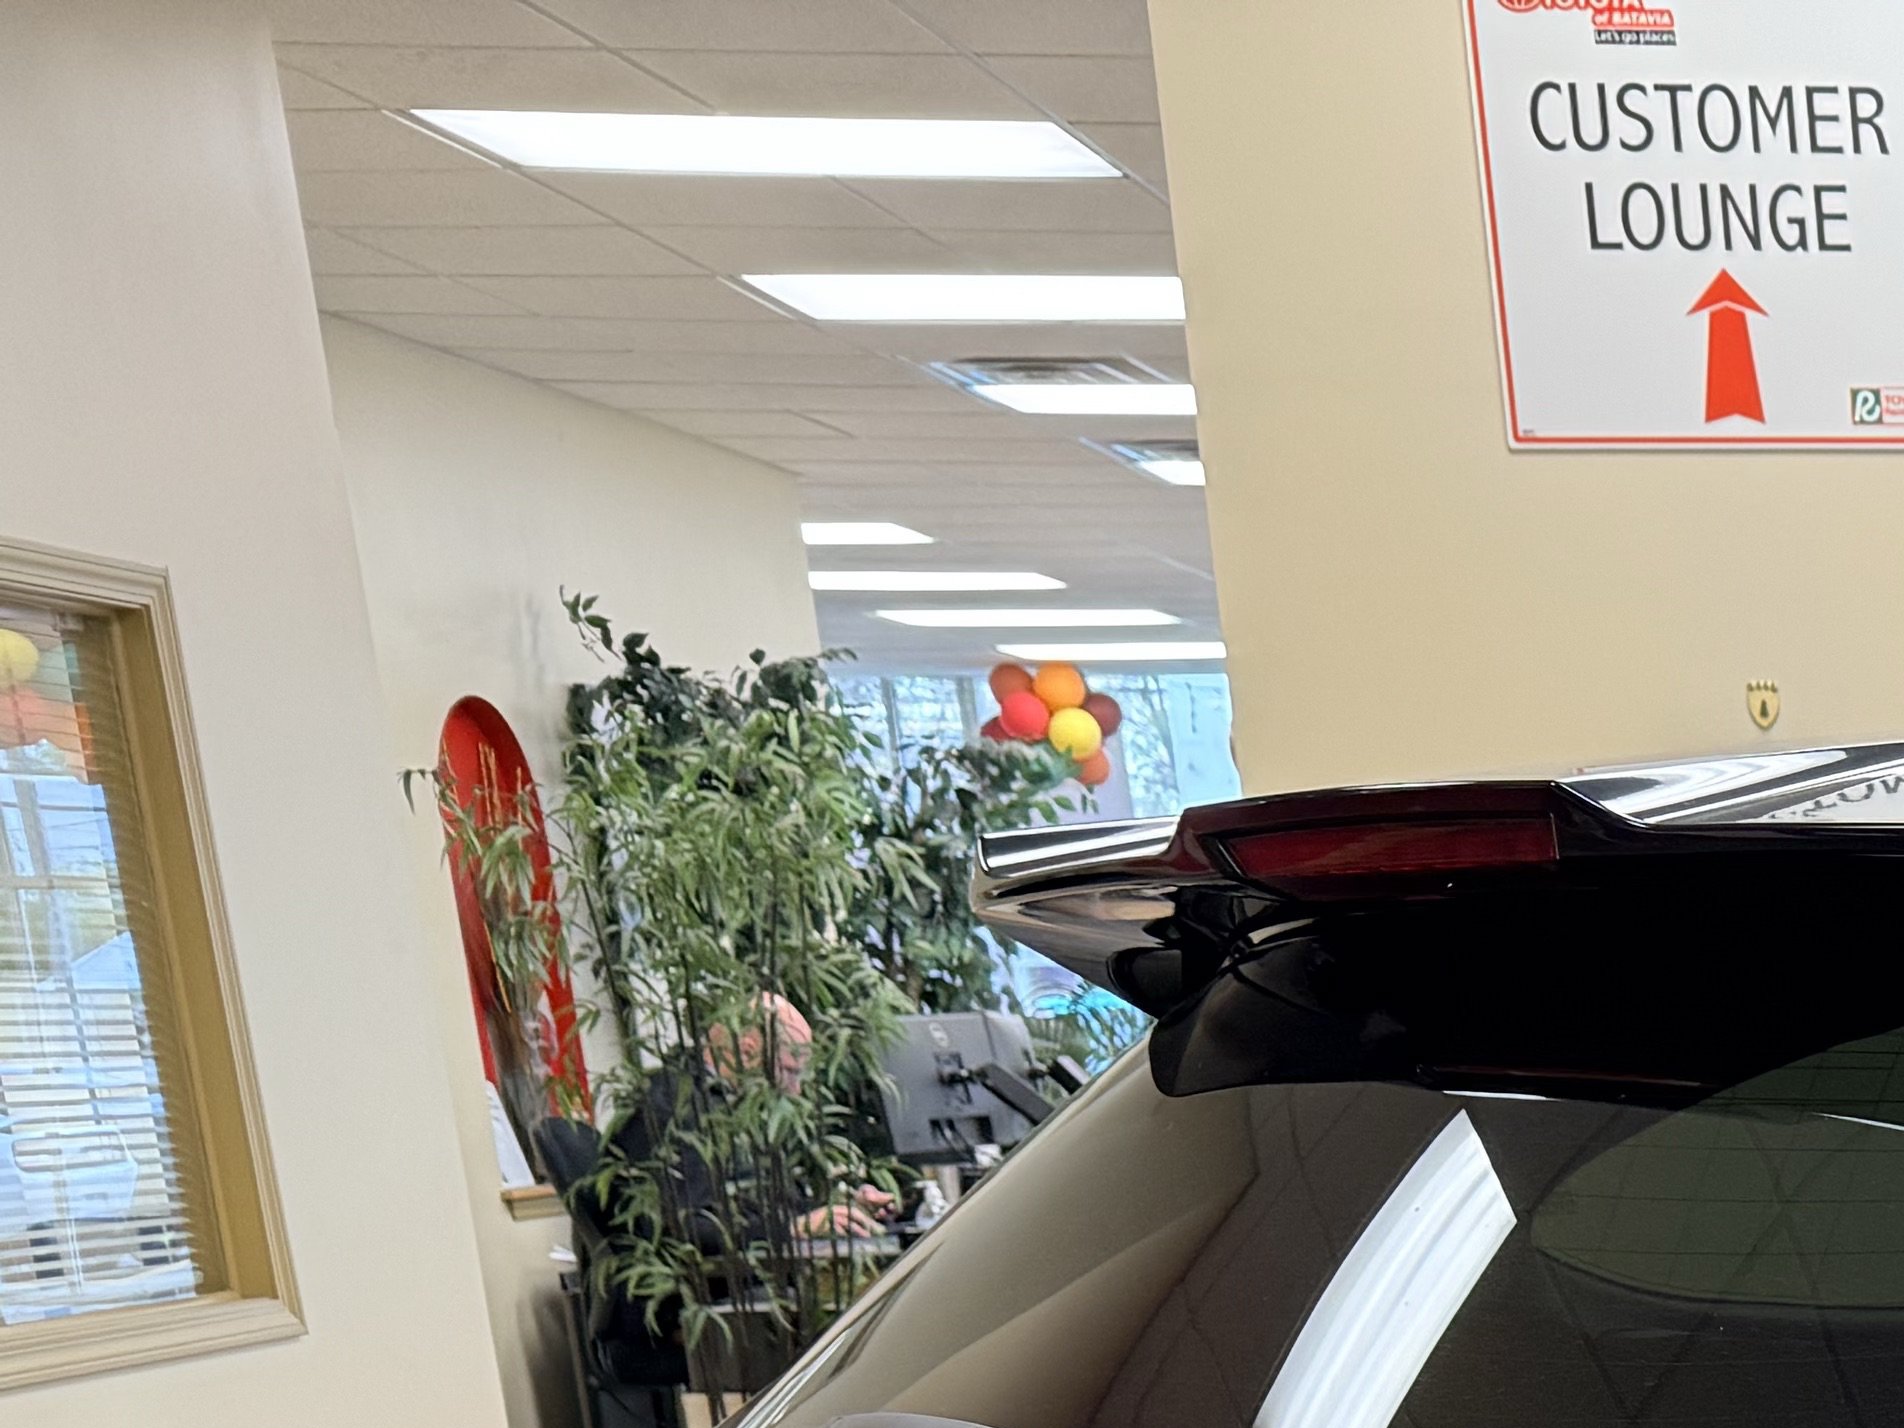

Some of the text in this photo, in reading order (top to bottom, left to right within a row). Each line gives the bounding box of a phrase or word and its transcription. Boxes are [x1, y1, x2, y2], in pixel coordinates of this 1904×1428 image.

[1611, 11, 1673, 25] BATAVIA
[1529, 80, 1891, 156] CUSTOMER
[1584, 181, 1854, 253] LOUNGE
